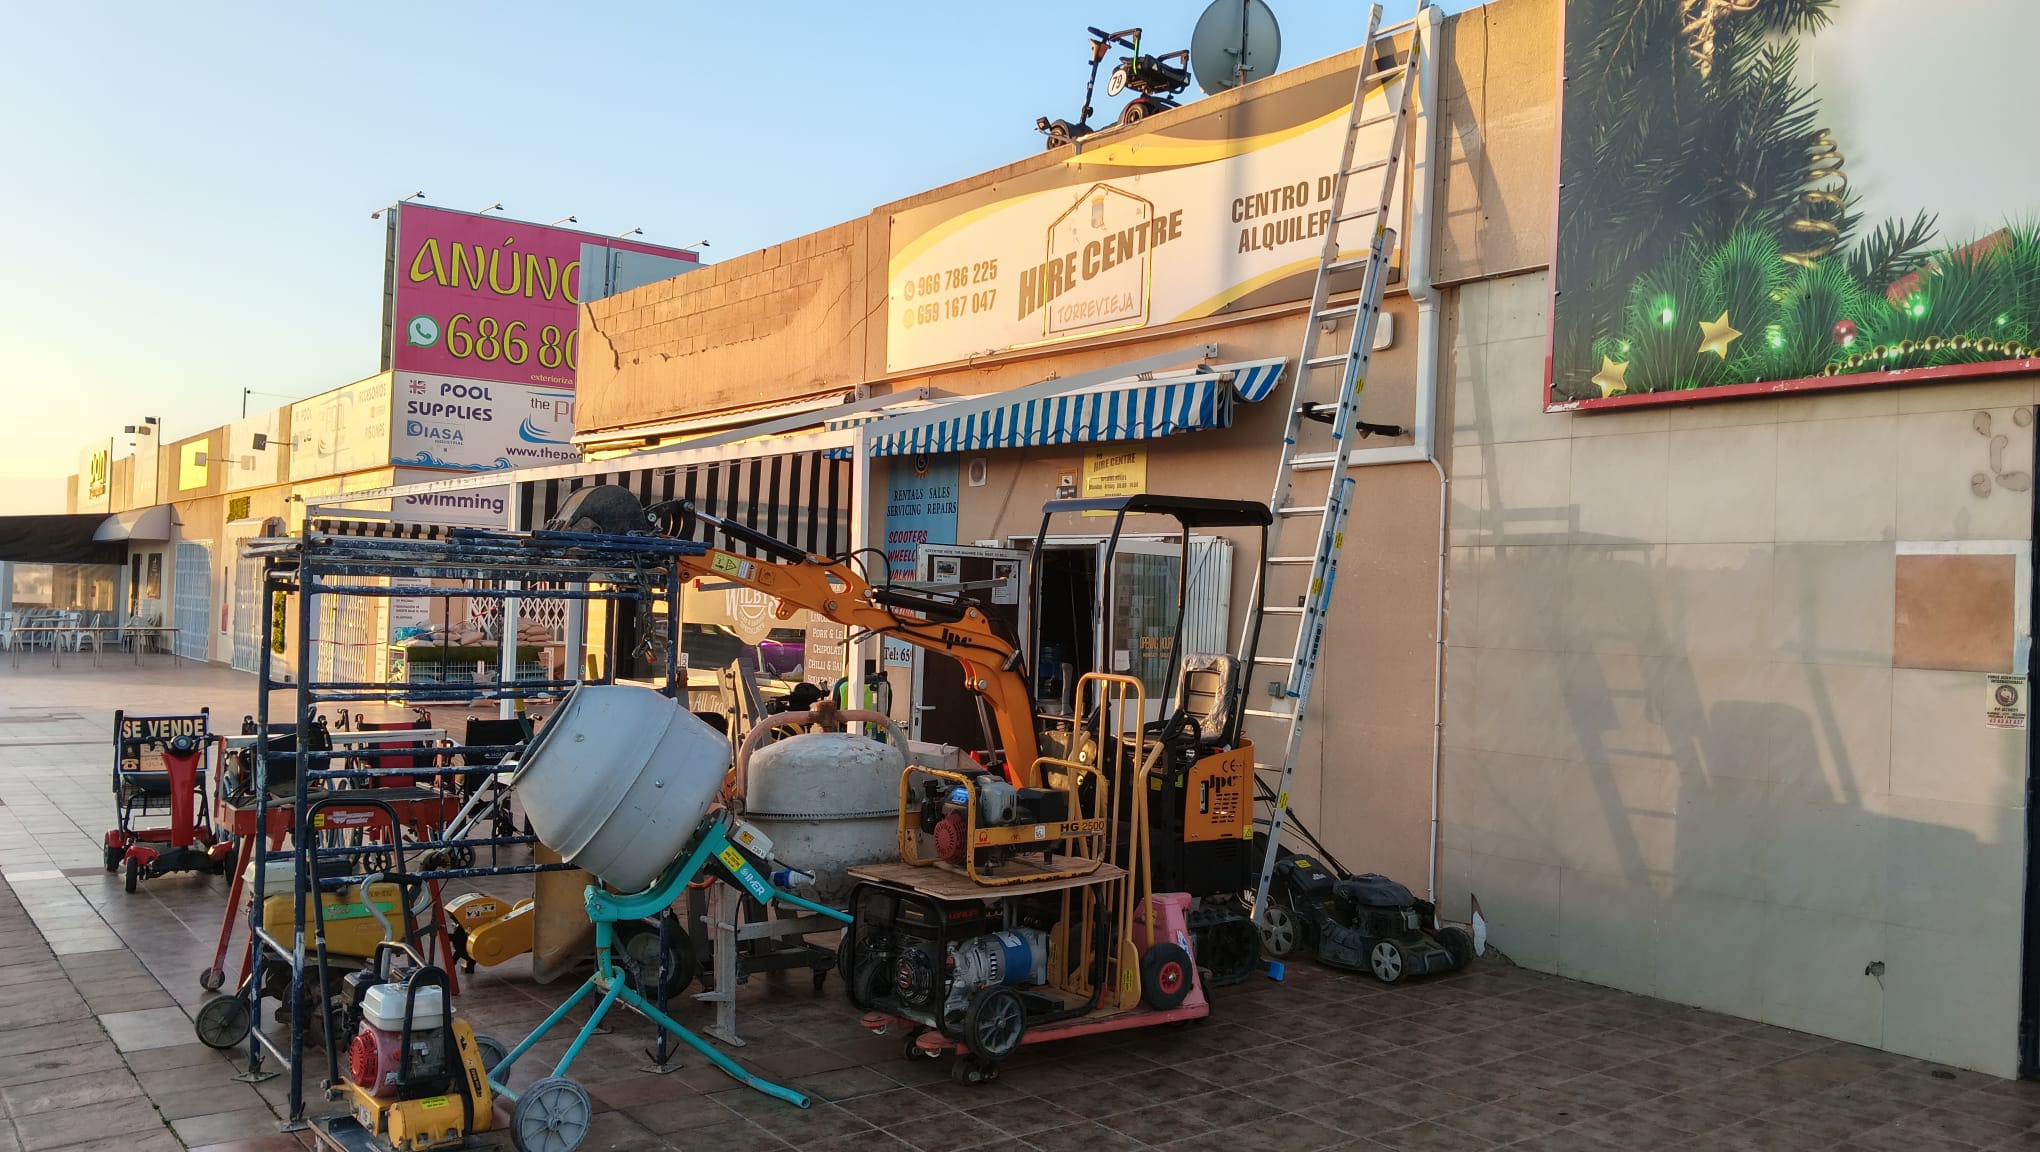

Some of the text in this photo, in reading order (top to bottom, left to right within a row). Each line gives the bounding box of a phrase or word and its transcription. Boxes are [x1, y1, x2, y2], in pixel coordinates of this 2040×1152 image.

[1111, 75, 1123, 90] 79
[1231, 181, 1310, 223] CENTRO
[1237, 209, 1332, 254] ALQUILER
[1017, 208, 1184, 321] HIRE CENTRE
[918, 258, 998, 296] 966 786 225
[917, 289, 997, 326] 659 167 047
[1057, 291, 1135, 325] TORREVIEJA
[446, 313, 530, 365] 686
[530, 374, 574, 385] exterioriza
[440, 383, 492, 401] POOL
[407, 401, 493, 422] SUPPLIES
[531, 398, 550, 410] the
[407, 420, 464, 441] DIASA
[1093, 459, 1109, 472] HIRE
[1110, 453, 1136, 467] CENTRE
[405, 492, 504, 514] Swimming
[894, 486, 951, 502] RENTALS SALES
[887, 502, 957, 517] SERVICING REPAIRS
[888, 530, 928, 544] SCOOTERS
[883, 646, 912, 662] Tel: 65
[808, 659, 826, 670] CHILLI
[122, 718, 203, 738] SE VENDE
[1060, 820, 1105, 833] HG 2500
